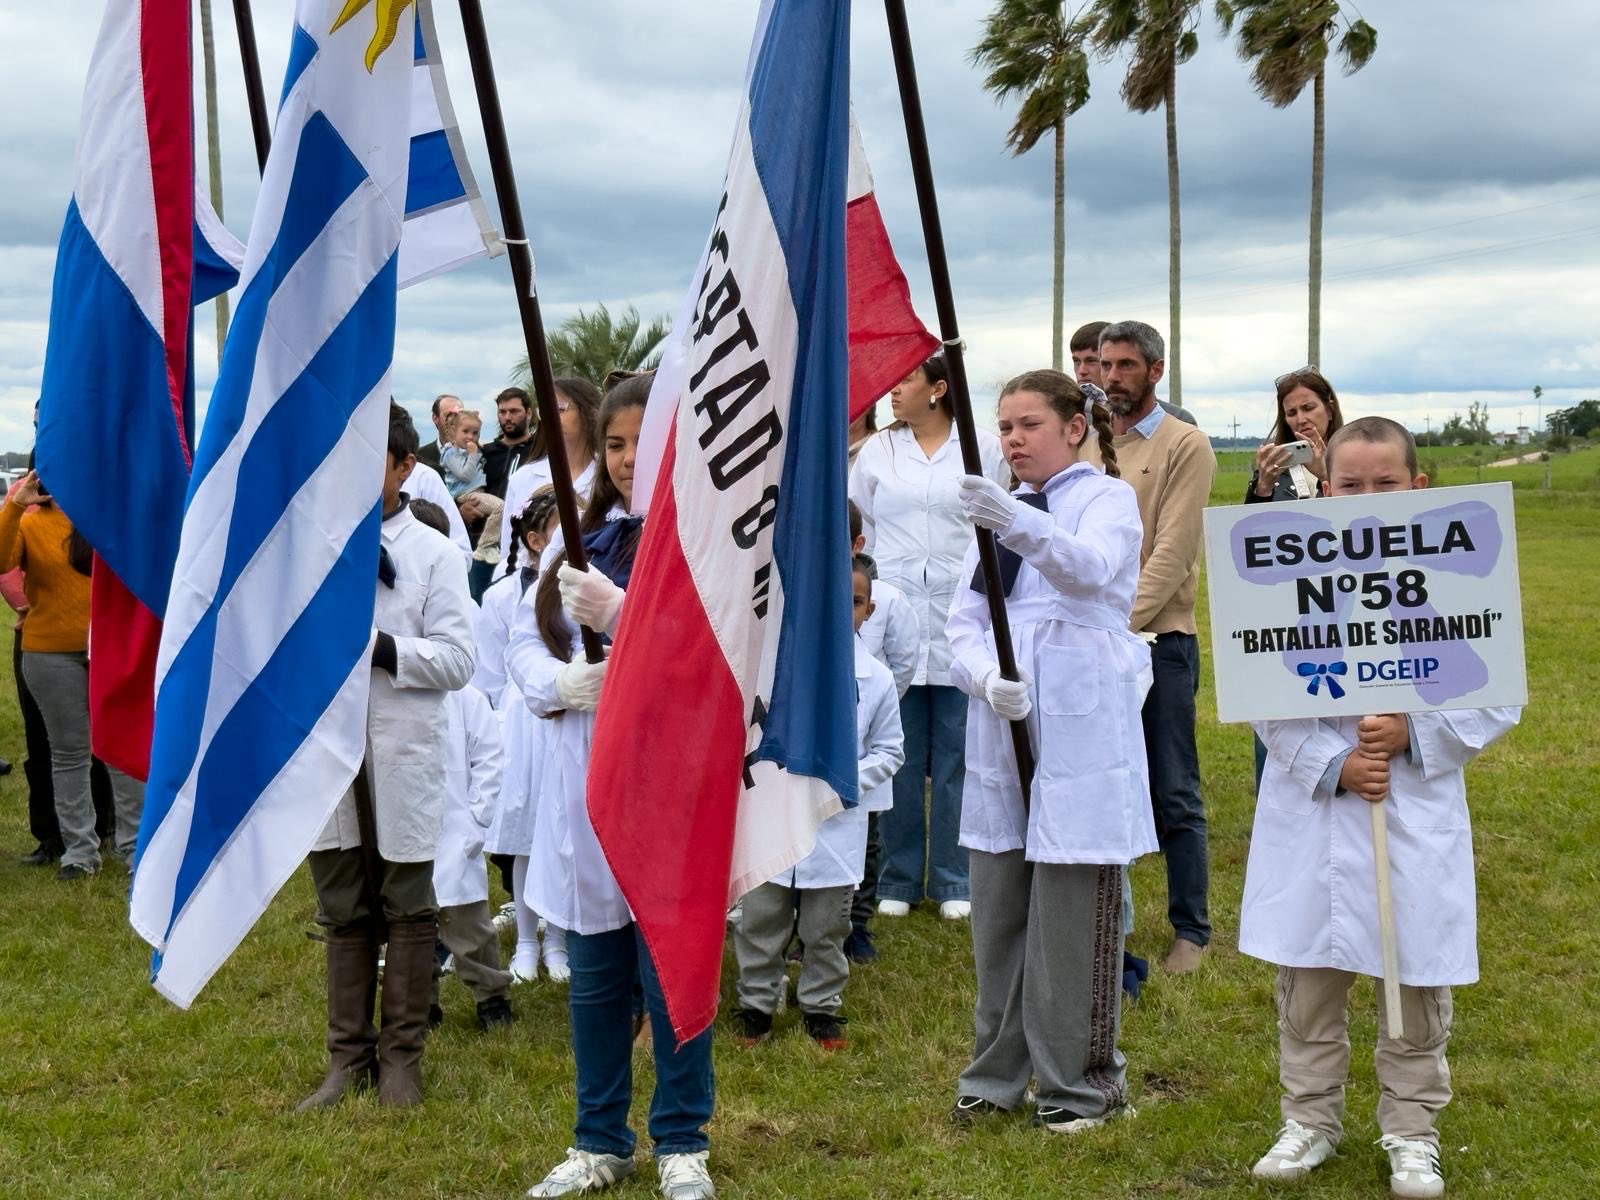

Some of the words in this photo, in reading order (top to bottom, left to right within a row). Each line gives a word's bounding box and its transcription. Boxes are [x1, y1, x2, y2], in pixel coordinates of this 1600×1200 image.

[1245, 520, 1476, 568] ESCUELA
[1347, 622, 1378, 647] DE
[1357, 657, 1439, 682] DGEIP
